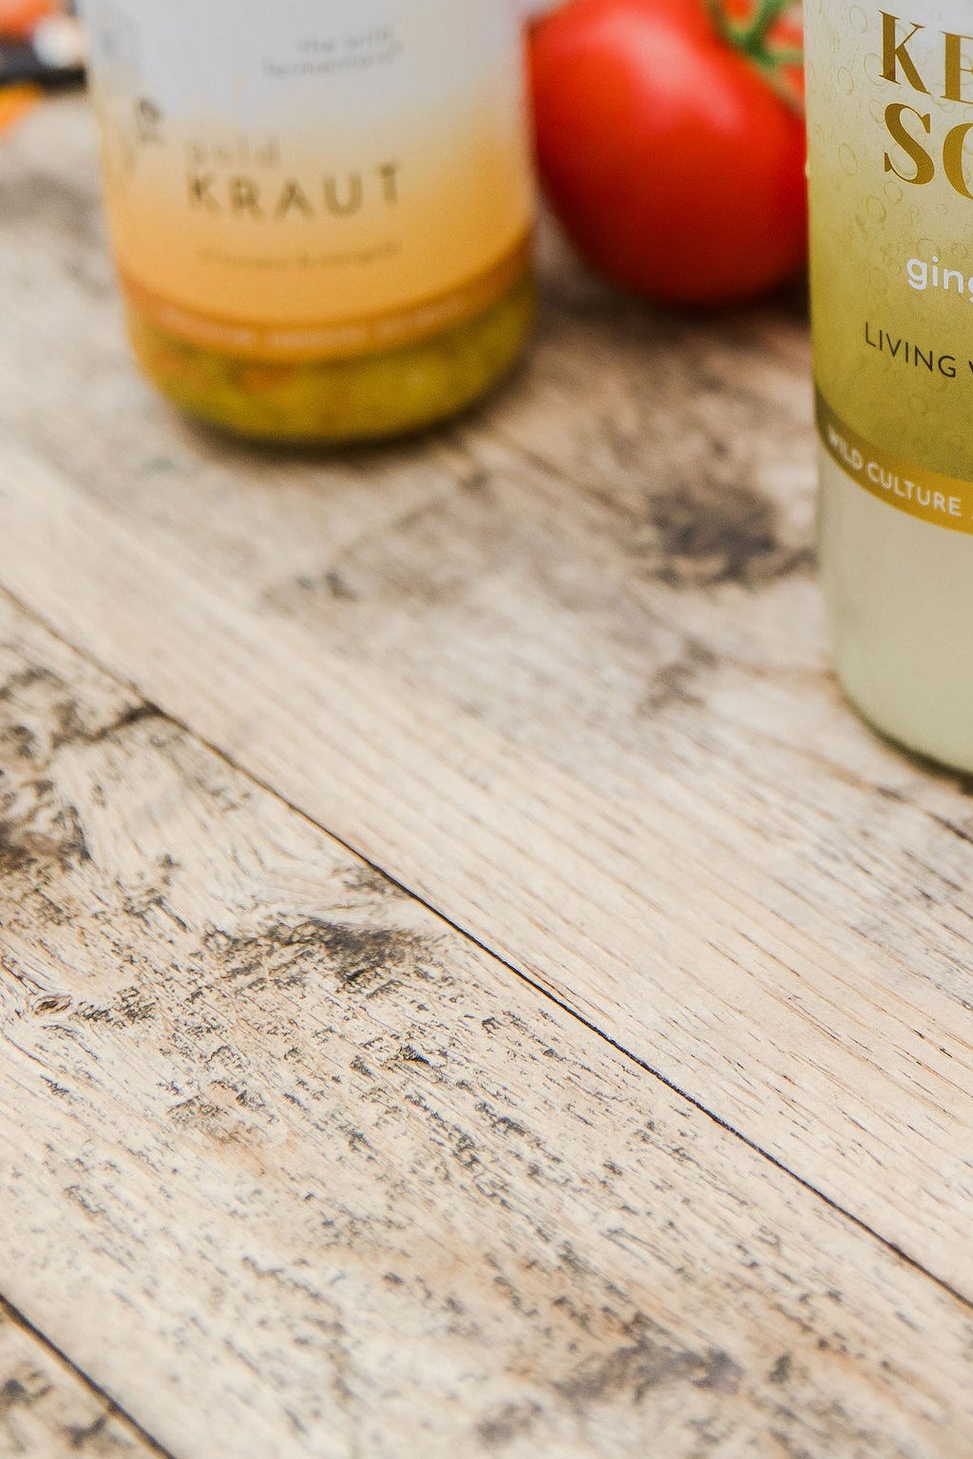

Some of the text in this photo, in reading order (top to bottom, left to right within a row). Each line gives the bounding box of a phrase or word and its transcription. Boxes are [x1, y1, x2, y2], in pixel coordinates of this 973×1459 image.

[186, 160, 402, 223] KRAUT
[864, 322, 957, 378] LIVING
[867, 458, 962, 517] CULTURE
